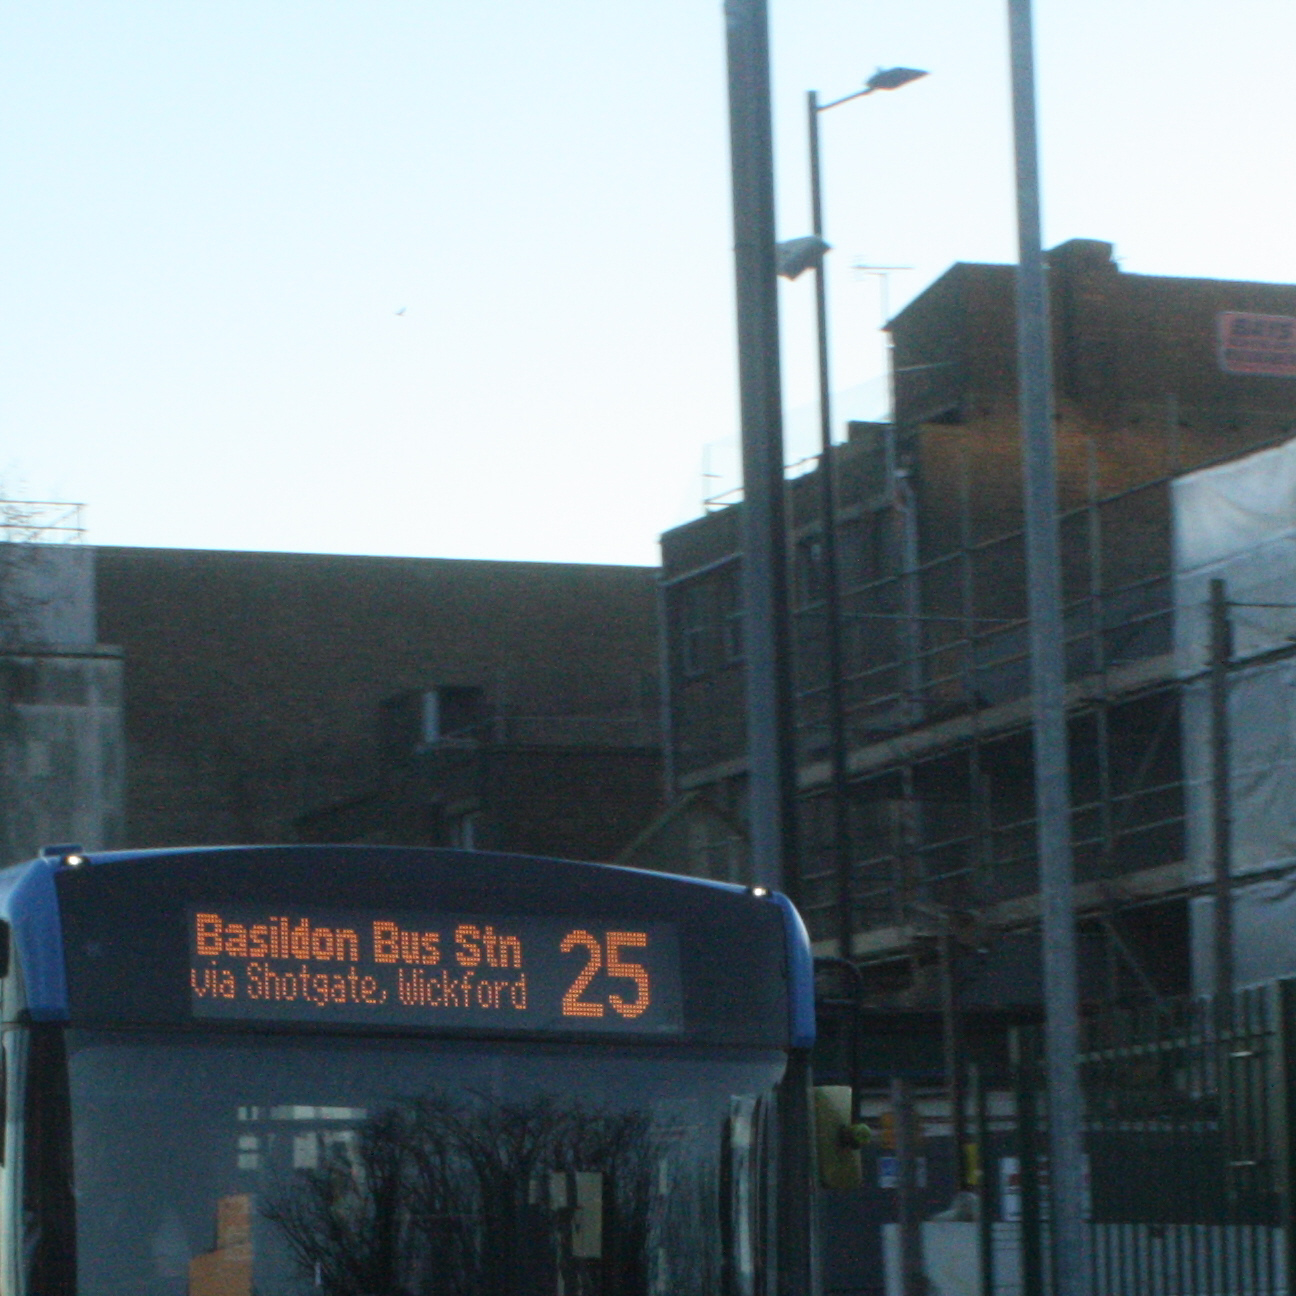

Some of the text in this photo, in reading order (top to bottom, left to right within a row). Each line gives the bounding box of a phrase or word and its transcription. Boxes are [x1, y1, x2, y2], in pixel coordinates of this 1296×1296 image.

[196, 912, 522, 968] Basildon Bus Stn
[190, 961, 528, 1010] via Shotgate, Wickford
[559, 929, 650, 1018] 25
